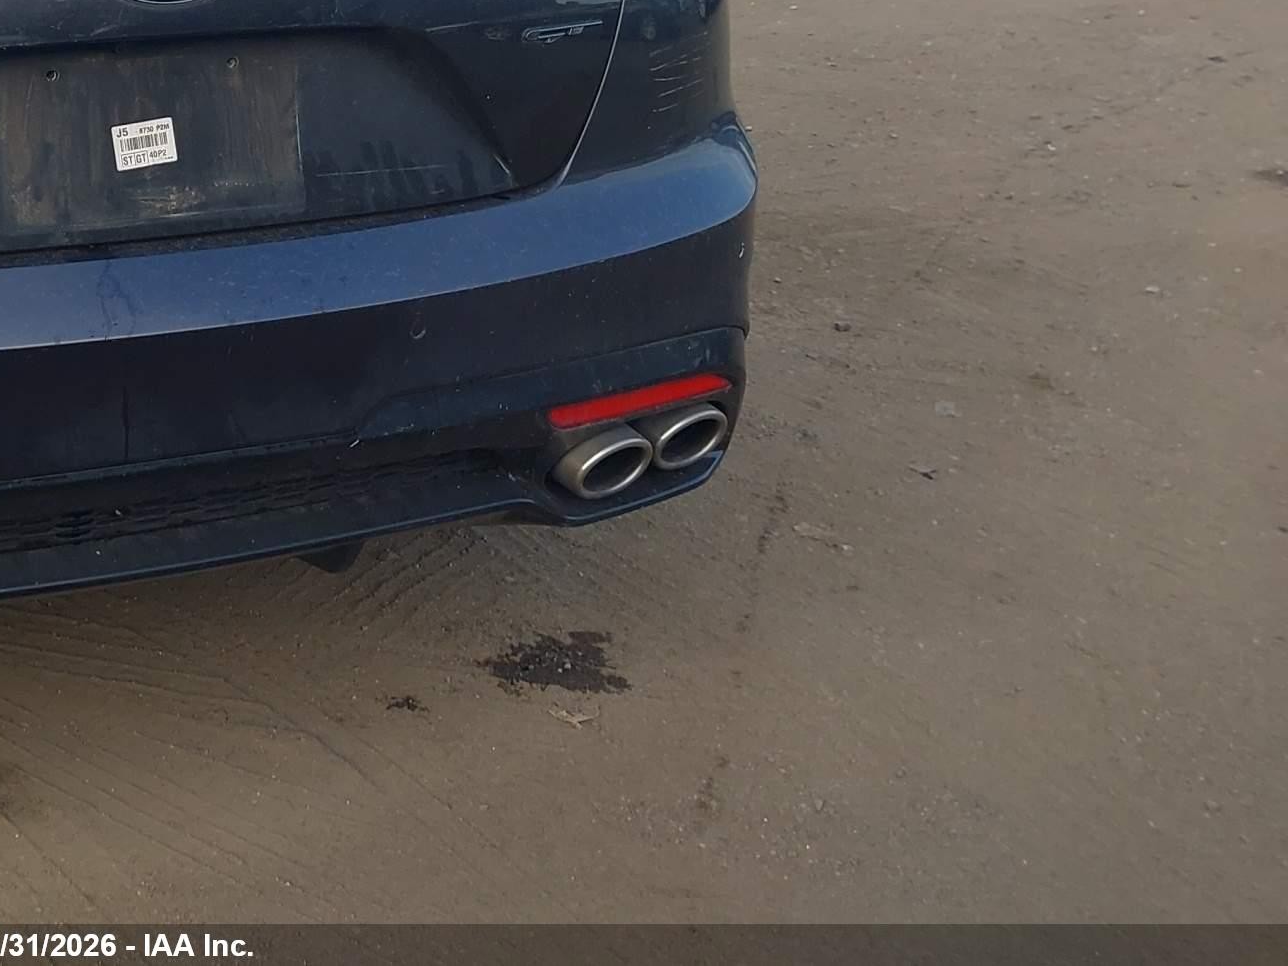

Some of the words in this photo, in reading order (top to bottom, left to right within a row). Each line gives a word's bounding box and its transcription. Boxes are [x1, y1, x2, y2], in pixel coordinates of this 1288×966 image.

[116, 127, 129, 138] J5
[123, 156, 134, 166] ST
[135, 153, 147, 164] GT
